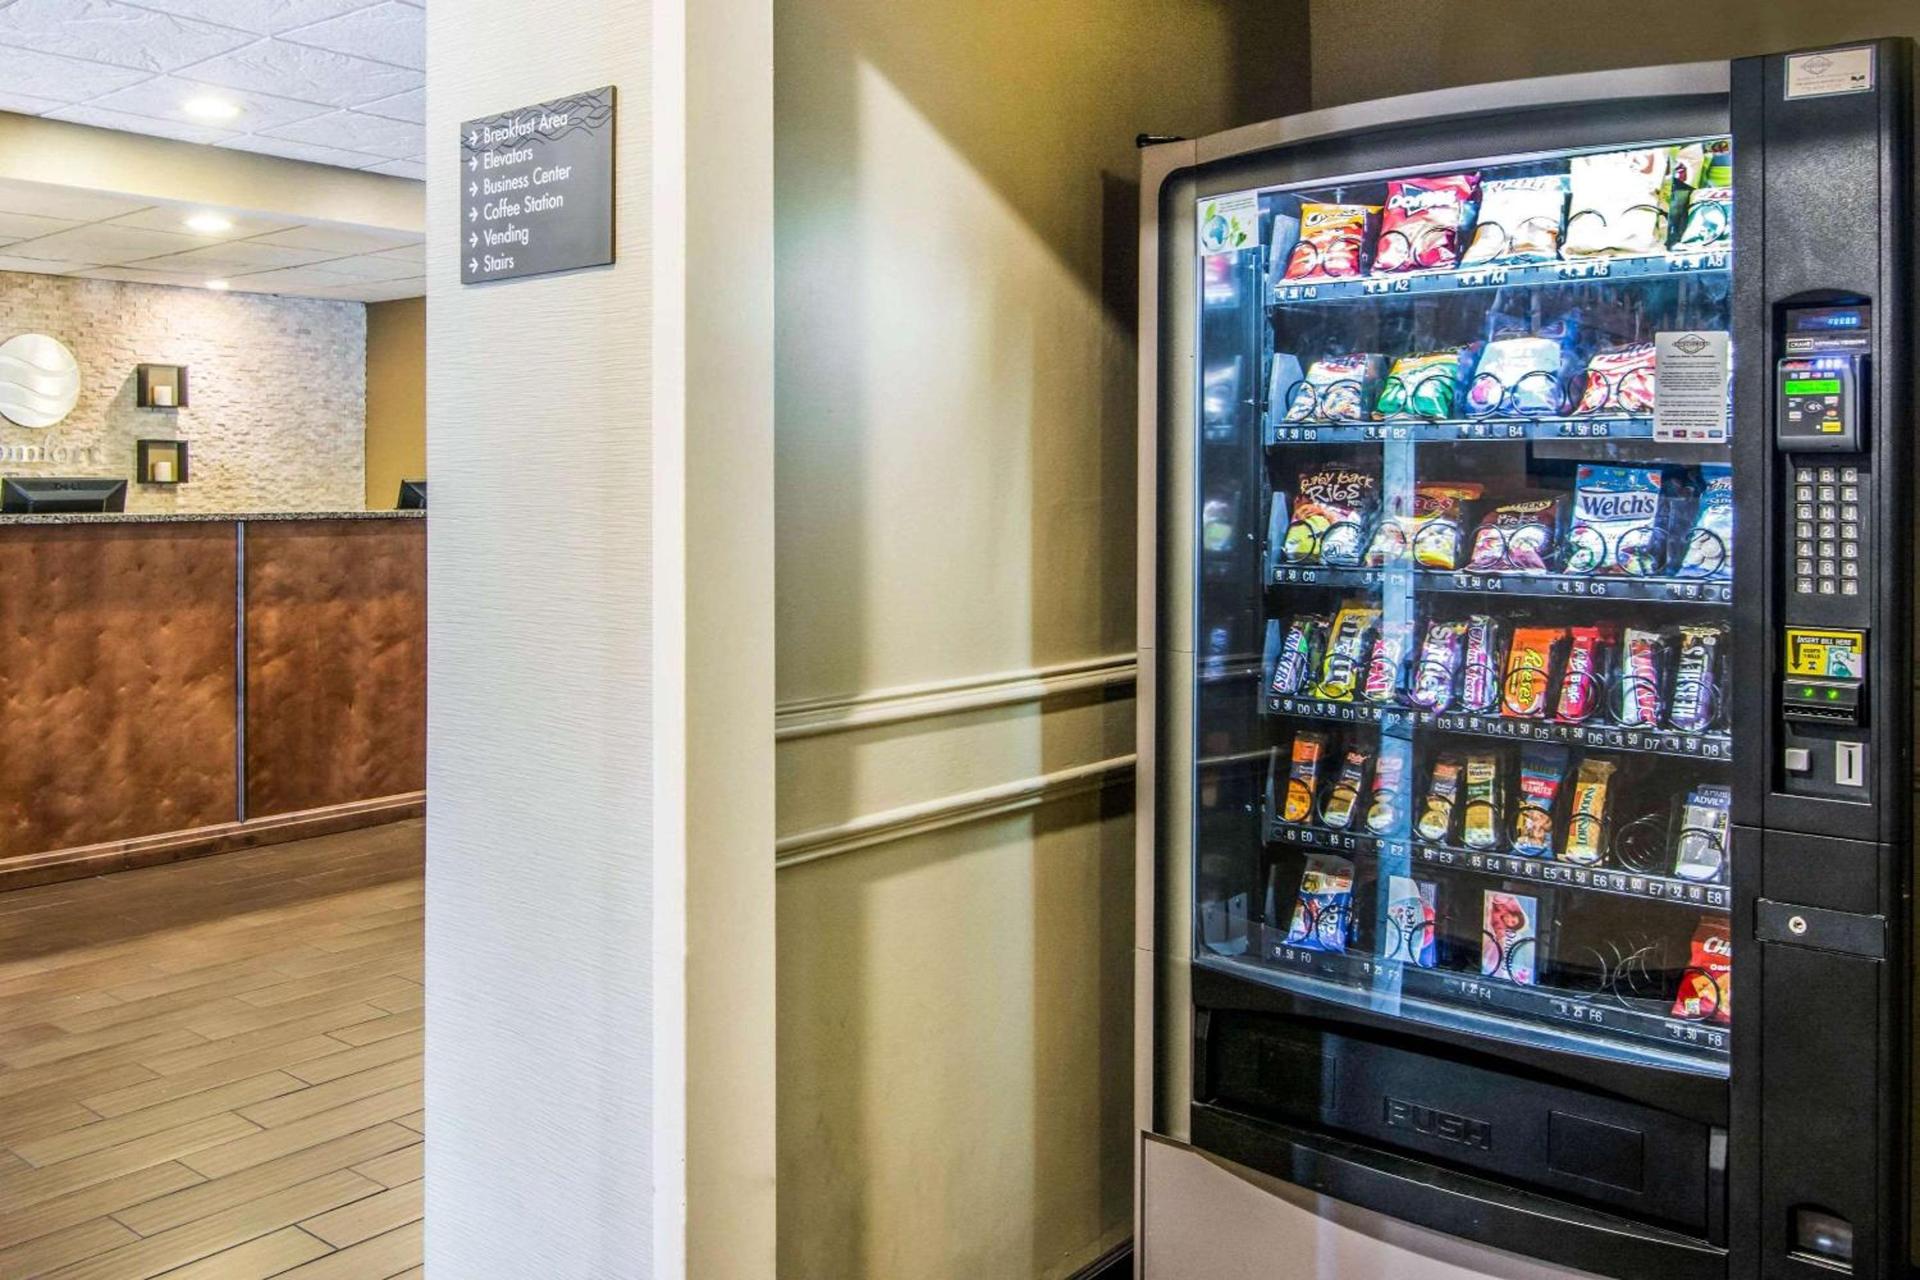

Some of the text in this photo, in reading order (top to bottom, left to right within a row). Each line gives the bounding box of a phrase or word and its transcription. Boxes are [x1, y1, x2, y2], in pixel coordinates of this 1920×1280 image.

[483, 114, 568, 143] Breakfast Area
[483, 147, 534, 170] Elevators
[483, 165, 573, 195] Business Center
[483, 193, 564, 221] Coffee Station
[483, 223, 530, 247] Vending
[483, 253, 515, 273] Stairs
[1707, 253, 1723, 267] A8
[1593, 263, 1608, 276] A6
[1491, 271, 1506, 284] A4
[1303, 285, 1317, 298] A0
[1394, 279, 1409, 292] A2
[1303, 427, 1317, 440] B0
[1393, 426, 1407, 439] B2
[1508, 426, 1523, 438] B4
[1592, 423, 1607, 436] B6
[1582, 495, 1655, 516] Welch's
[1302, 571, 1315, 582] C0
[1487, 579, 1502, 591] C4
[1590, 582, 1606, 595] C6
[1272, 628, 1302, 692] SNICKERS
[1518, 647, 1545, 705] Reese's
[1671, 646, 1705, 718] HERSHEY'S
[1297, 704, 1310, 715] D0
[1342, 708, 1354, 719] D1
[1387, 713, 1400, 724] D2
[1437, 718, 1451, 730] D3
[1487, 722, 1501, 734] D4
[1534, 727, 1549, 739] D5
[1588, 732, 1604, 745] D6
[1644, 737, 1661, 751] D7
[1703, 743, 1719, 757] D8
[1301, 831, 1313, 842] E0
[1344, 837, 1355, 849] E1
[1390, 845, 1403, 856] E2
[1439, 850, 1452, 862] E3
[1486, 858, 1499, 870] E4
[1543, 867, 1557, 880] E5
[1593, 874, 1607, 888] E6
[1649, 880, 1664, 895] E7
[1707, 890, 1722, 905] E8
[1300, 951, 1312, 963] F0
[1479, 987, 1492, 999] F4
[1589, 1009, 1603, 1023] F6
[1708, 1033, 1722, 1047] F8
[1383, 1096, 1492, 1150] PUSH
